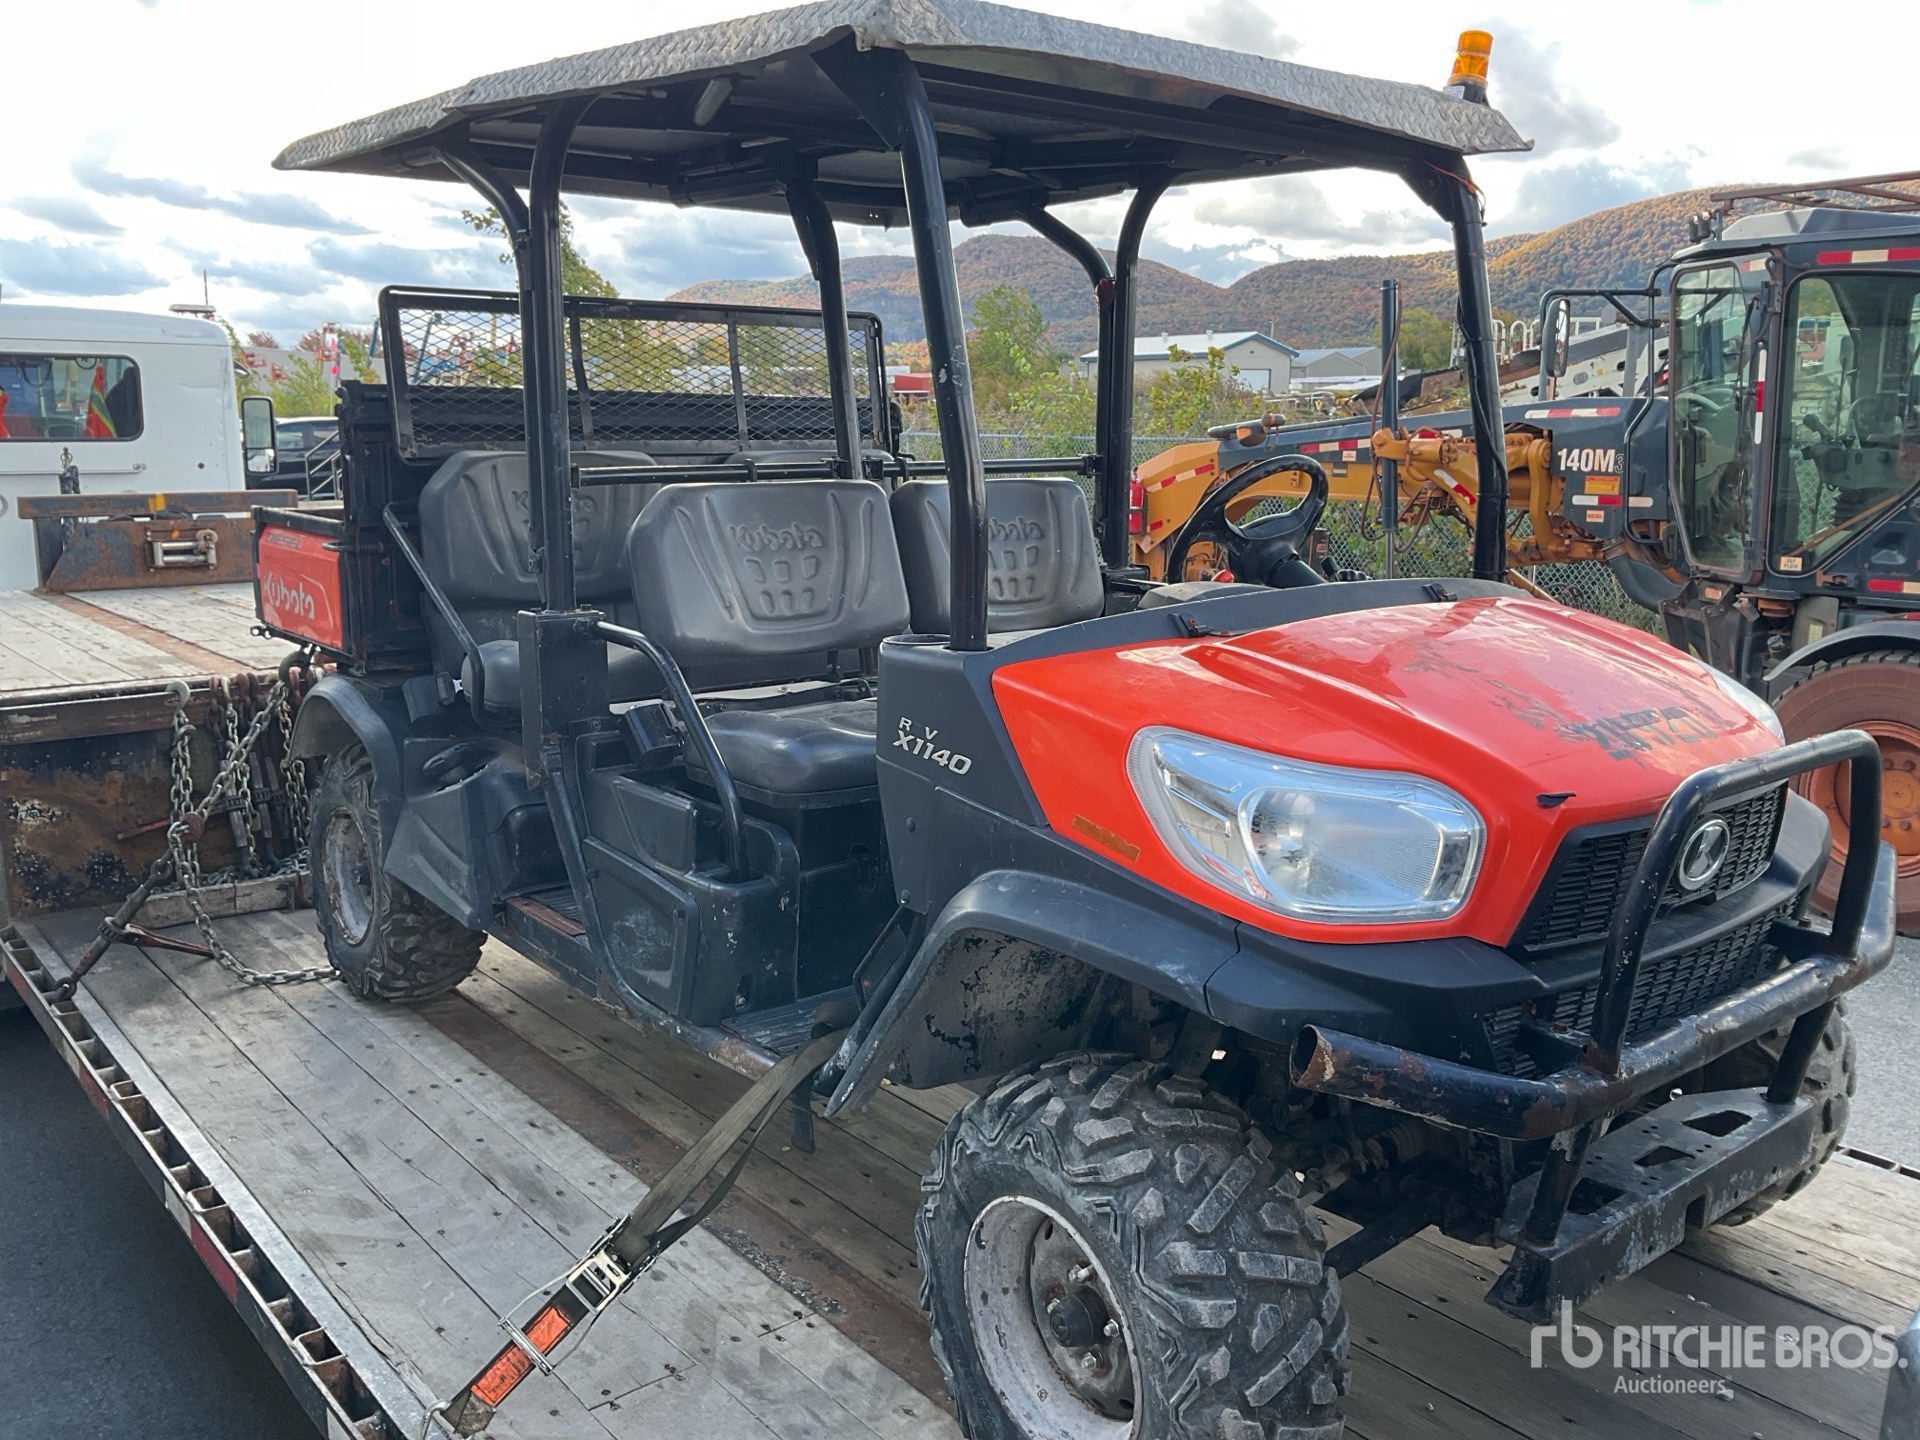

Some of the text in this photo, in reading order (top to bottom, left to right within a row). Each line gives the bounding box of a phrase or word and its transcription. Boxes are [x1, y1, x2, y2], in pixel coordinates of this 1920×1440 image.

[728, 522, 823, 551] Kubota
[263, 571, 315, 620] Kubota
[892, 729, 972, 775] X1140
